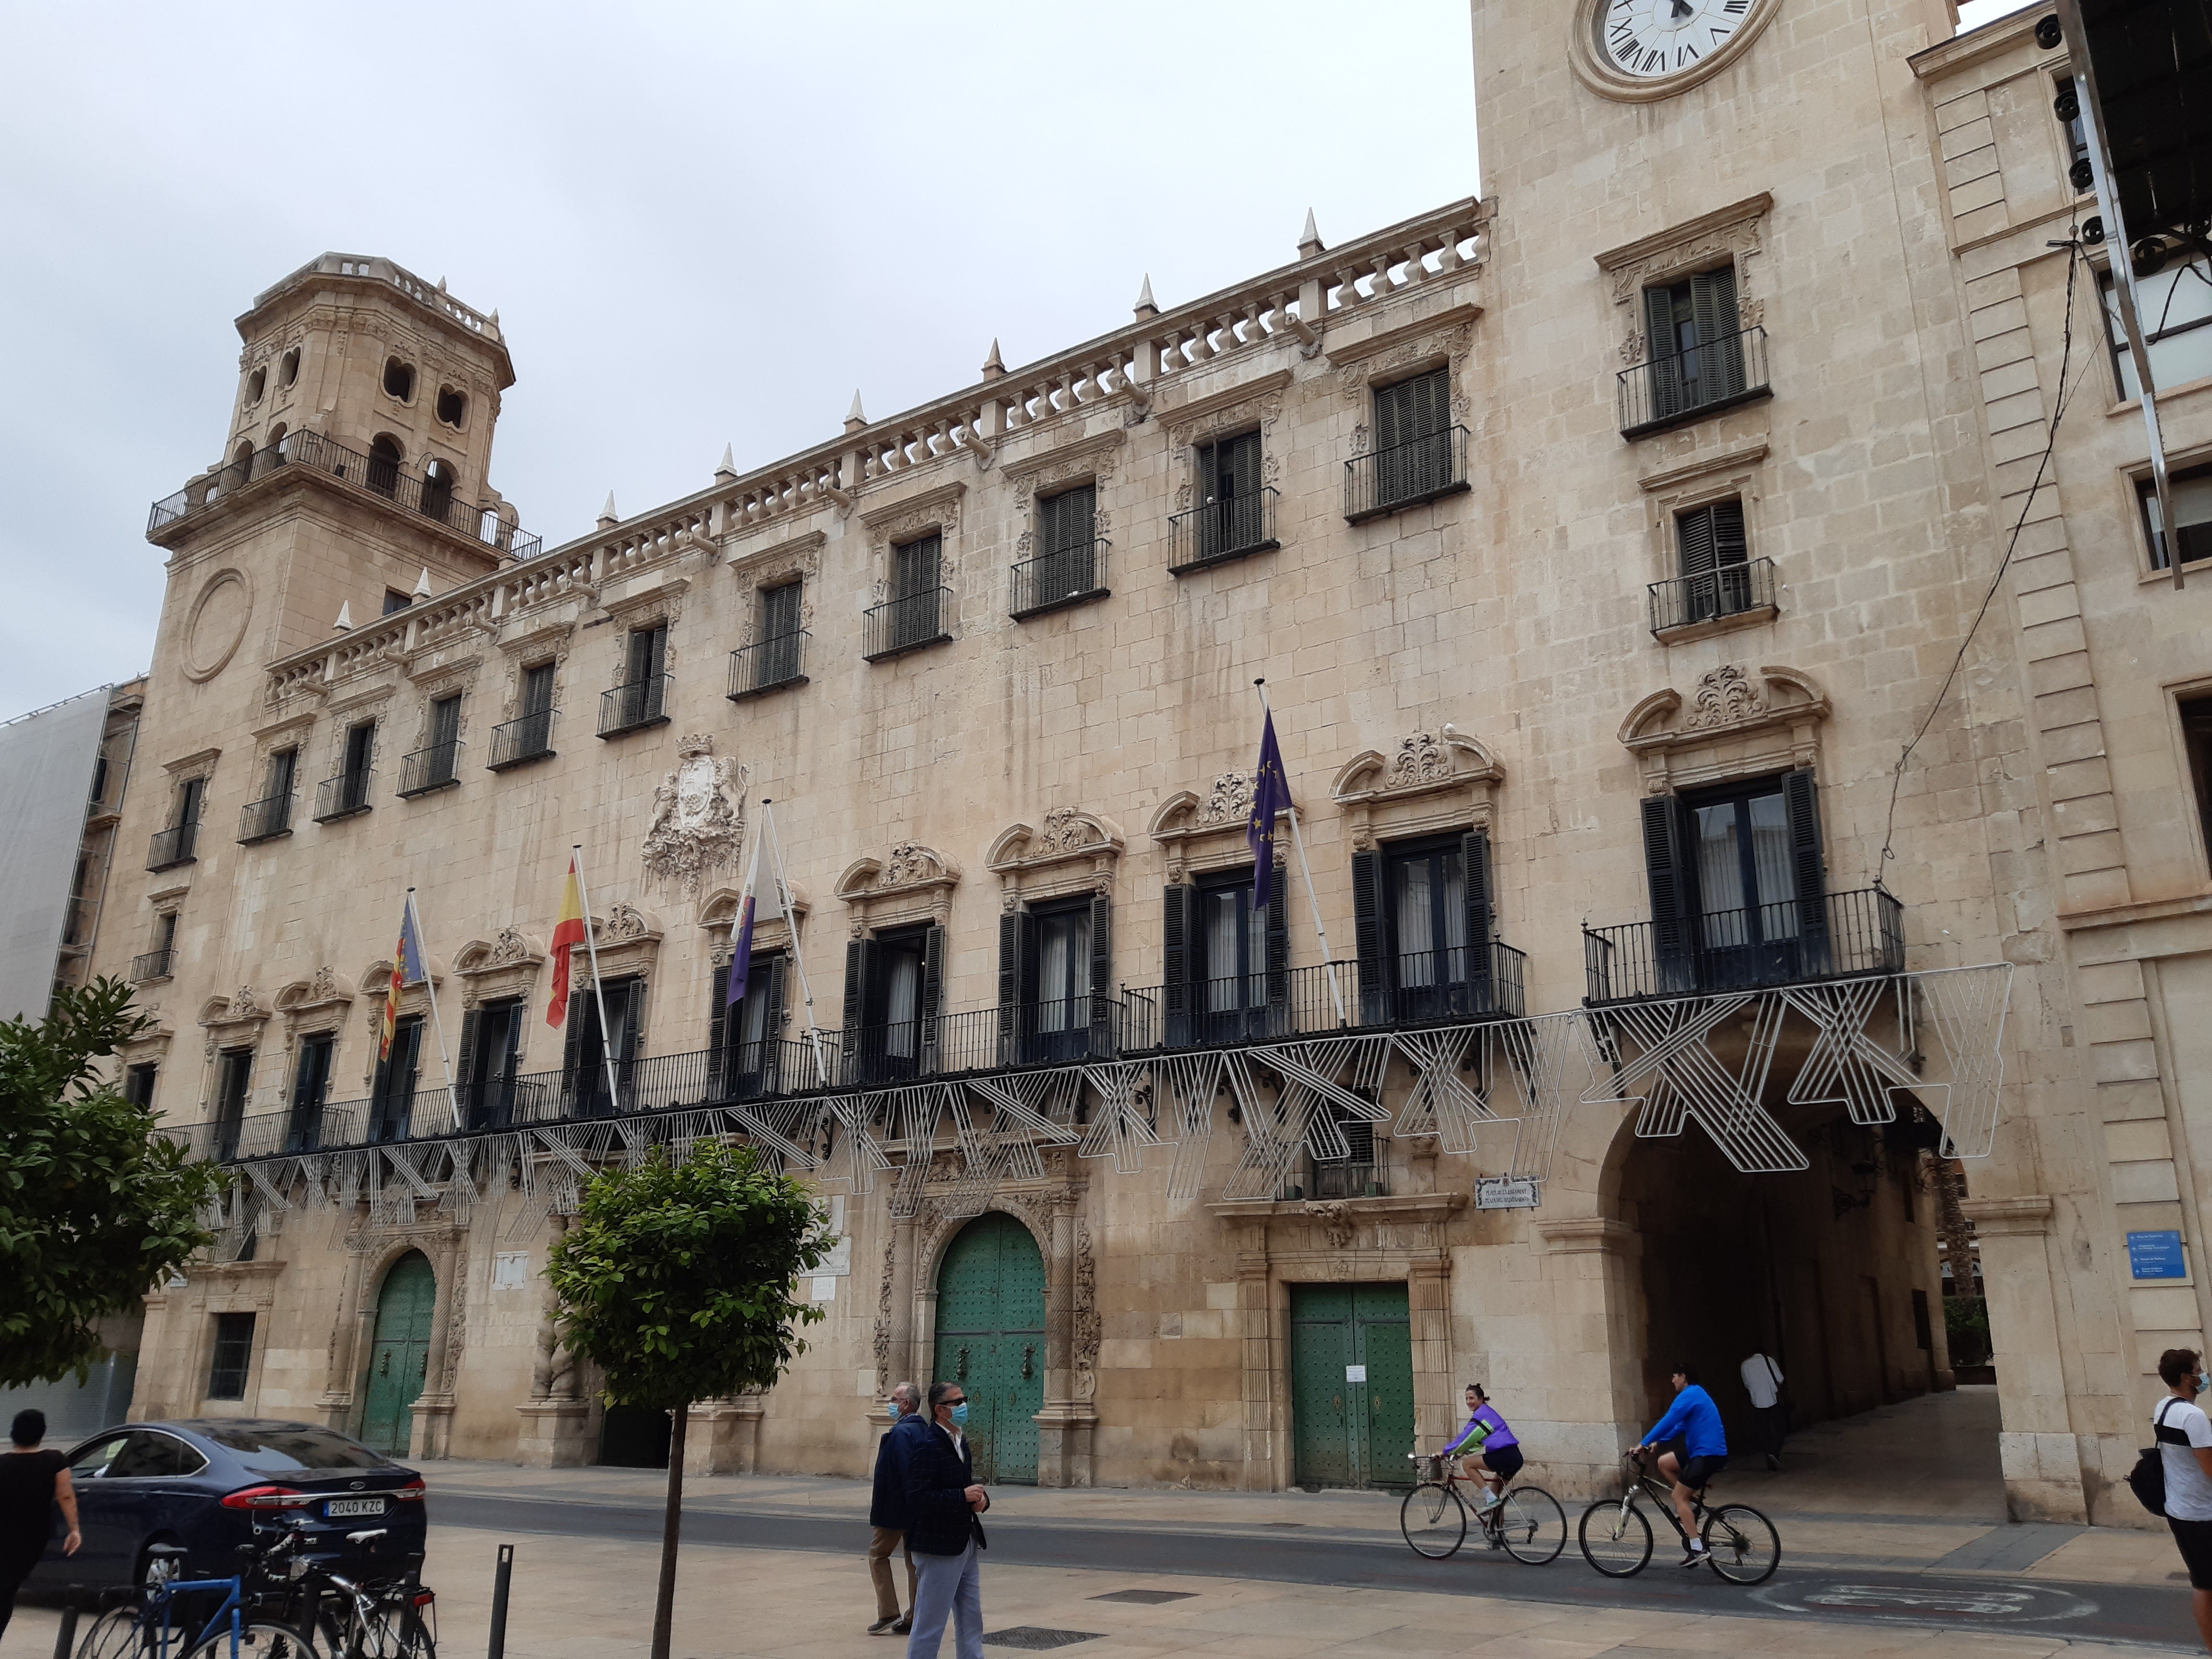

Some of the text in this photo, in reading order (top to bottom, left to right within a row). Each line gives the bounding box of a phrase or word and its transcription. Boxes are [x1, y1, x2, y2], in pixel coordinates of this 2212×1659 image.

[1610, 17, 1633, 46] IX
[1710, 28, 1731, 46] V
[1616, 38, 1645, 69] VIII
[1640, 49, 1665, 72] VII
[1677, 43, 1699, 67] VI
[332, 1501, 382, 1514] 2040 KZC
